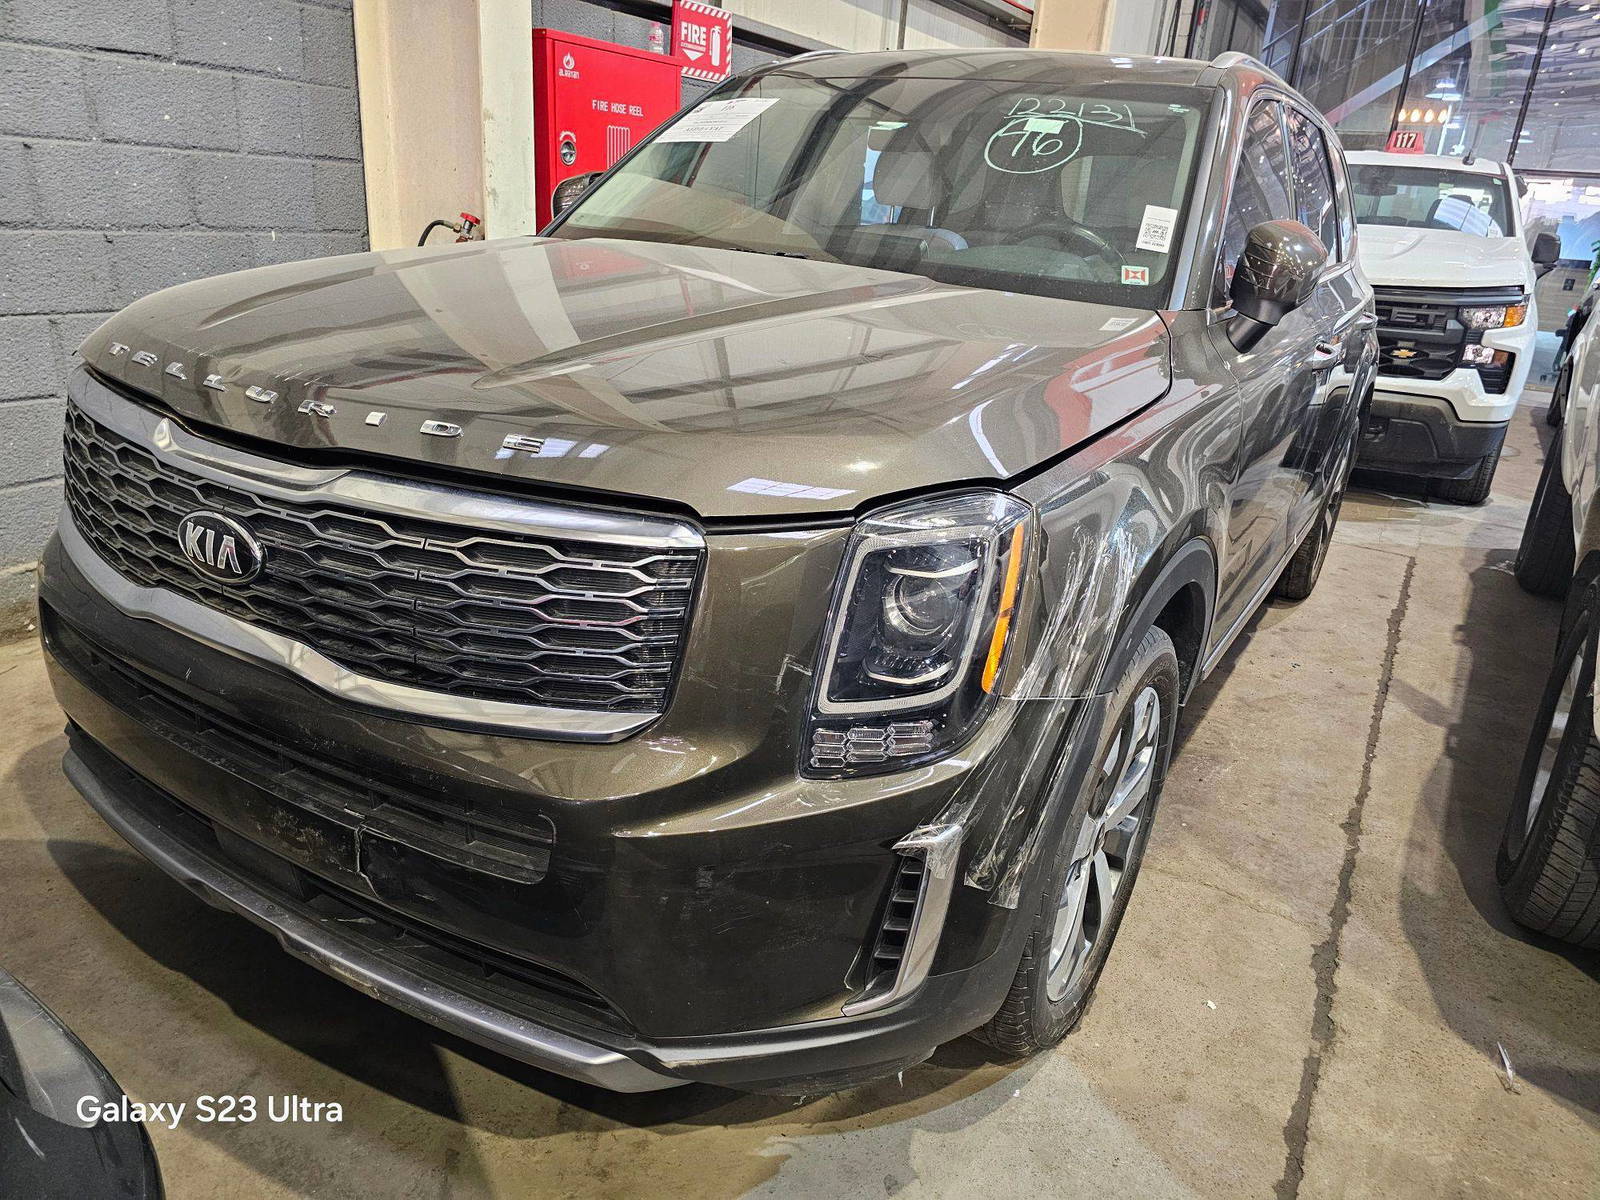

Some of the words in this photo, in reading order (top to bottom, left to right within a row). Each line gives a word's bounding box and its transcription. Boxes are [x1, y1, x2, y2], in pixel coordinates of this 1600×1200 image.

[681, 21, 706, 46] FIRE
[592, 99, 608, 112] FIRE
[611, 102, 627, 115] HOSE
[629, 104, 644, 117] REEL
[1395, 132, 1418, 149] 117
[108, 341, 546, 455] TELLURIDE
[185, 521, 242, 575] KIA
